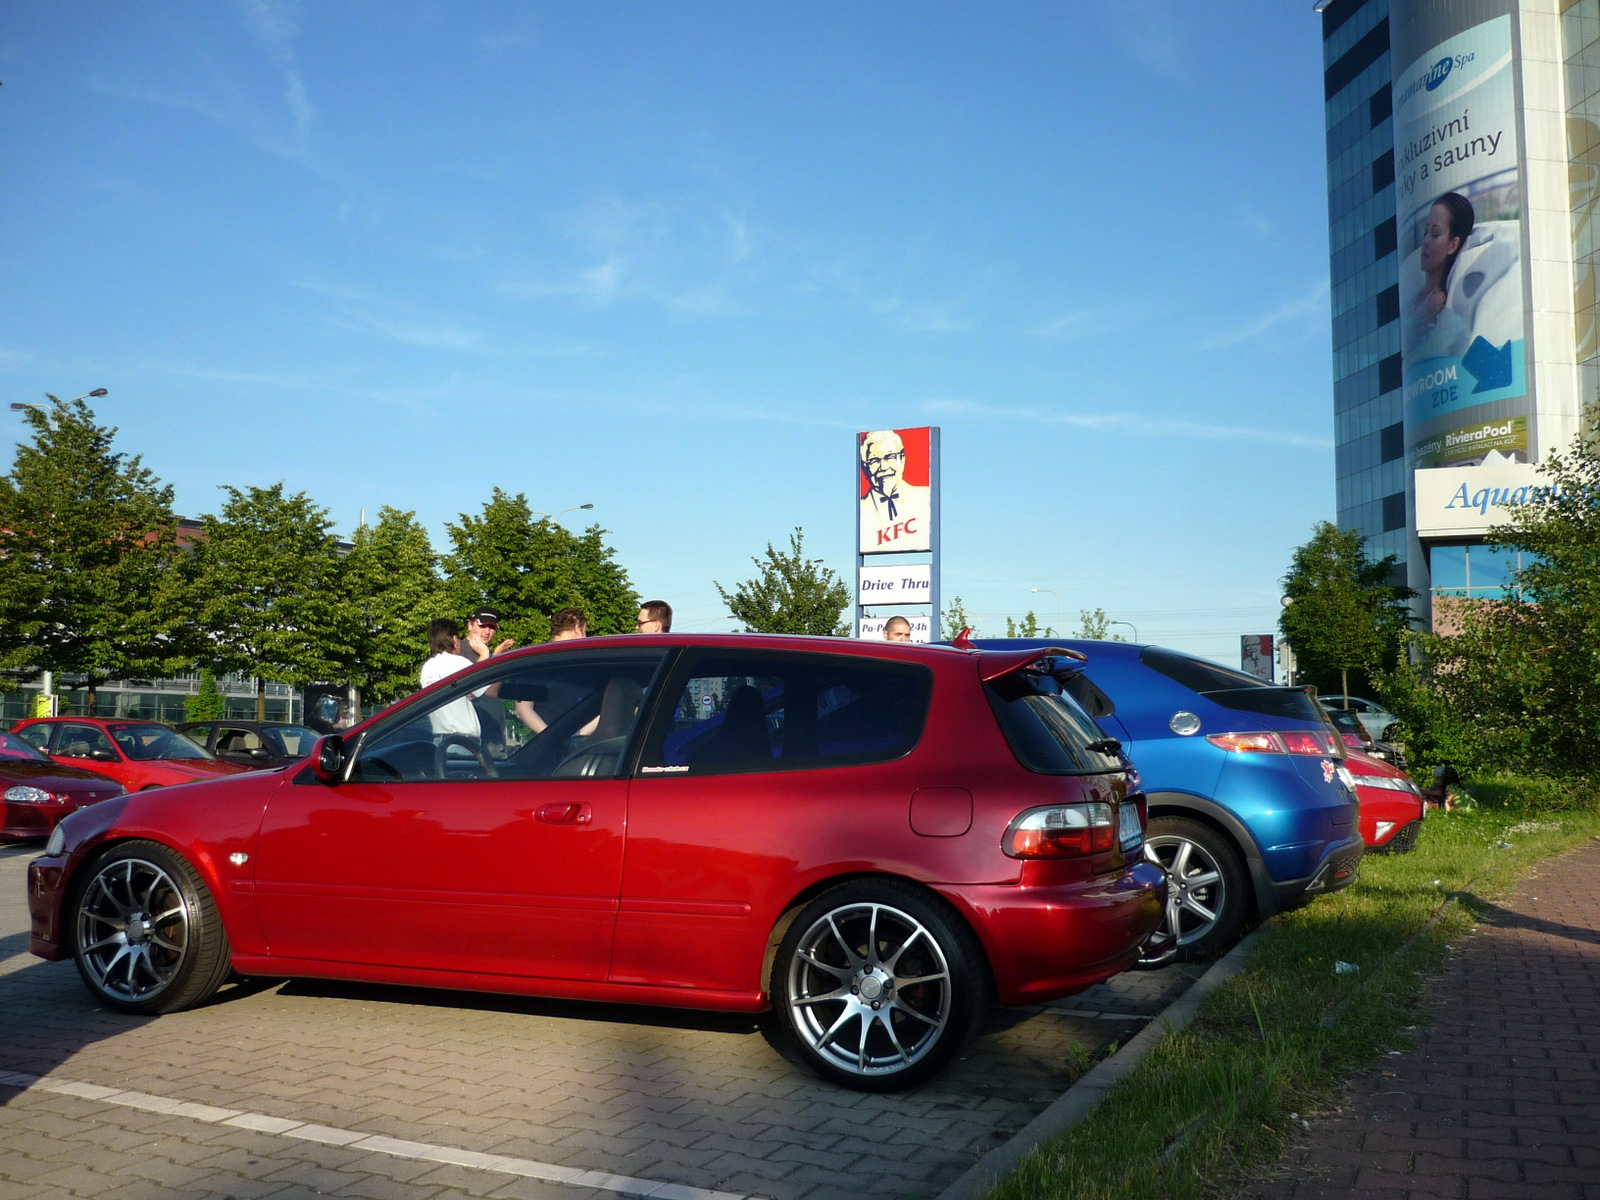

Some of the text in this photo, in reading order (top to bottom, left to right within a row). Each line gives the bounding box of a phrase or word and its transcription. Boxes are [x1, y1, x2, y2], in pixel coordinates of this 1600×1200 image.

[1454, 52, 1475, 70] Spa
[1420, 164, 1429, 181] a
[1434, 131, 1502, 172] sauny
[1432, 385, 1458, 408] ZDE
[1445, 421, 1512, 447] RivieraPool
[877, 517, 918, 546] KFC
[861, 578, 930, 591] Drive Thru
